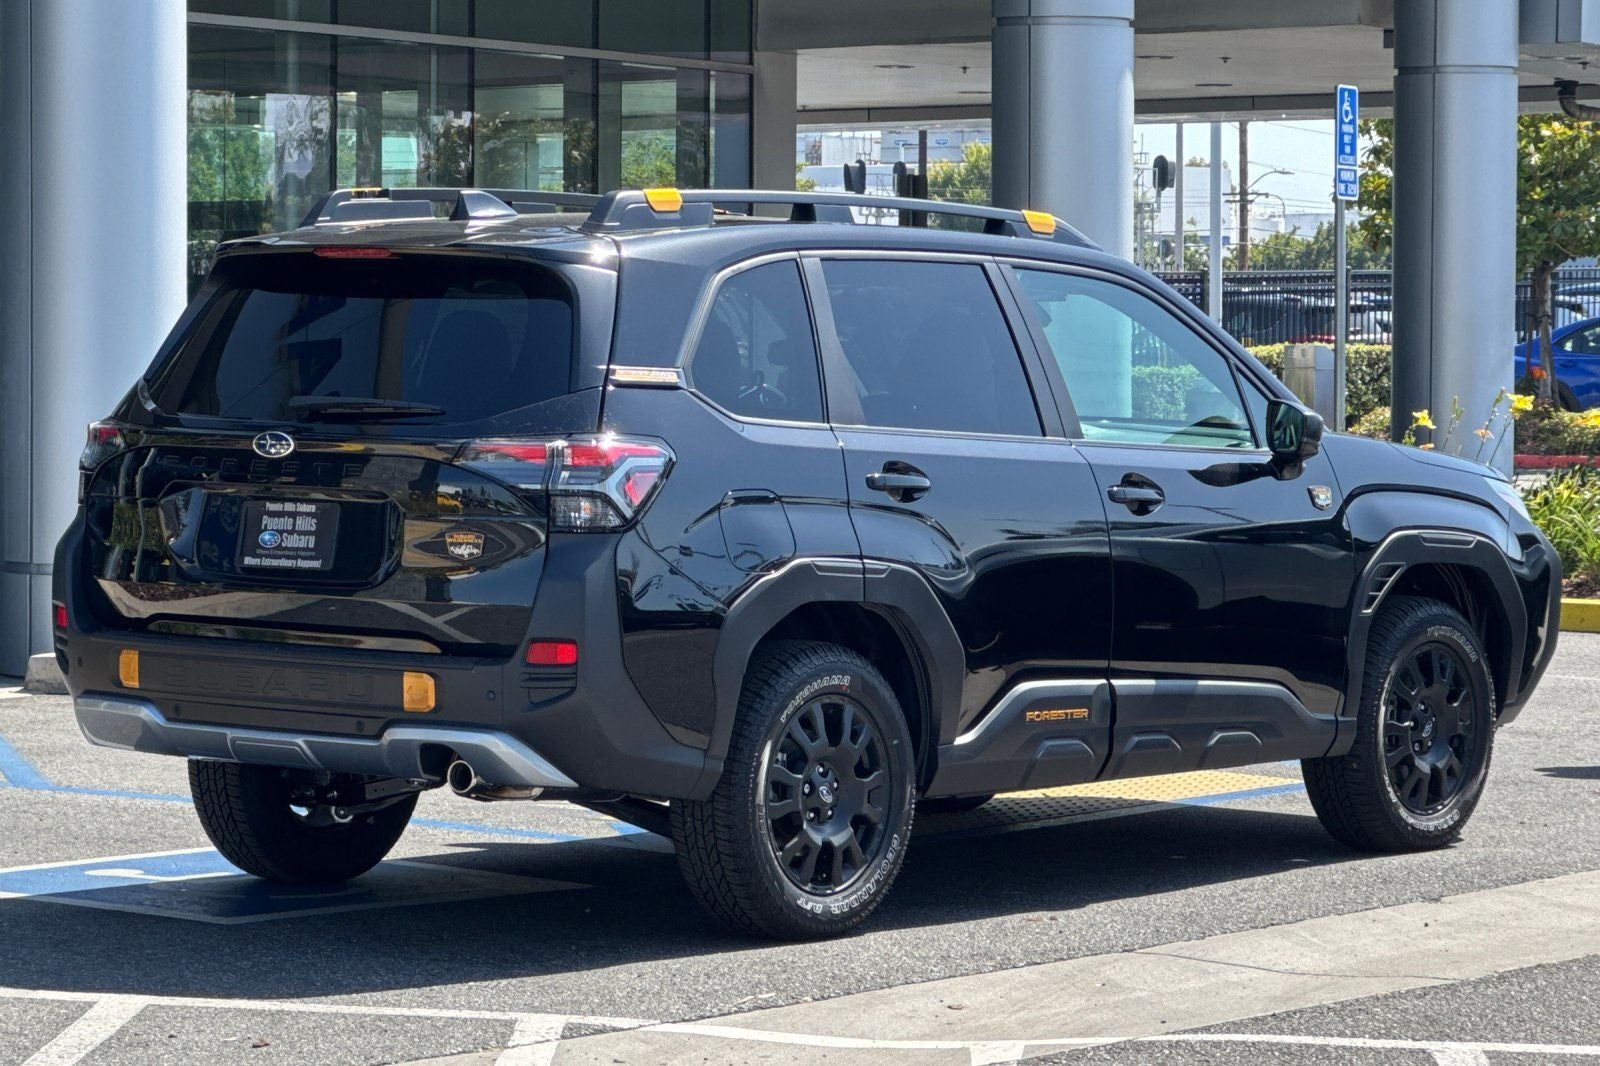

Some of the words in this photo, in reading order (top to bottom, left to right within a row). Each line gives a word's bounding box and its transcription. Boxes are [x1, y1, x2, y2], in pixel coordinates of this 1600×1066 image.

[163, 455, 398, 480] FORESTER
[296, 503, 316, 512] Subaru
[261, 515, 293, 530] Puente
[295, 515, 317, 531] Hills
[282, 533, 315, 548] Subaru
[261, 556, 297, 567] Extraordinary
[160, 663, 375, 703] SUBARU
[780, 674, 851, 724] YOKOHAMA
[1025, 708, 1089, 722] FORESTER
[831, 834, 901, 914] GEOLANDAR
[797, 897, 823, 914] A/T
